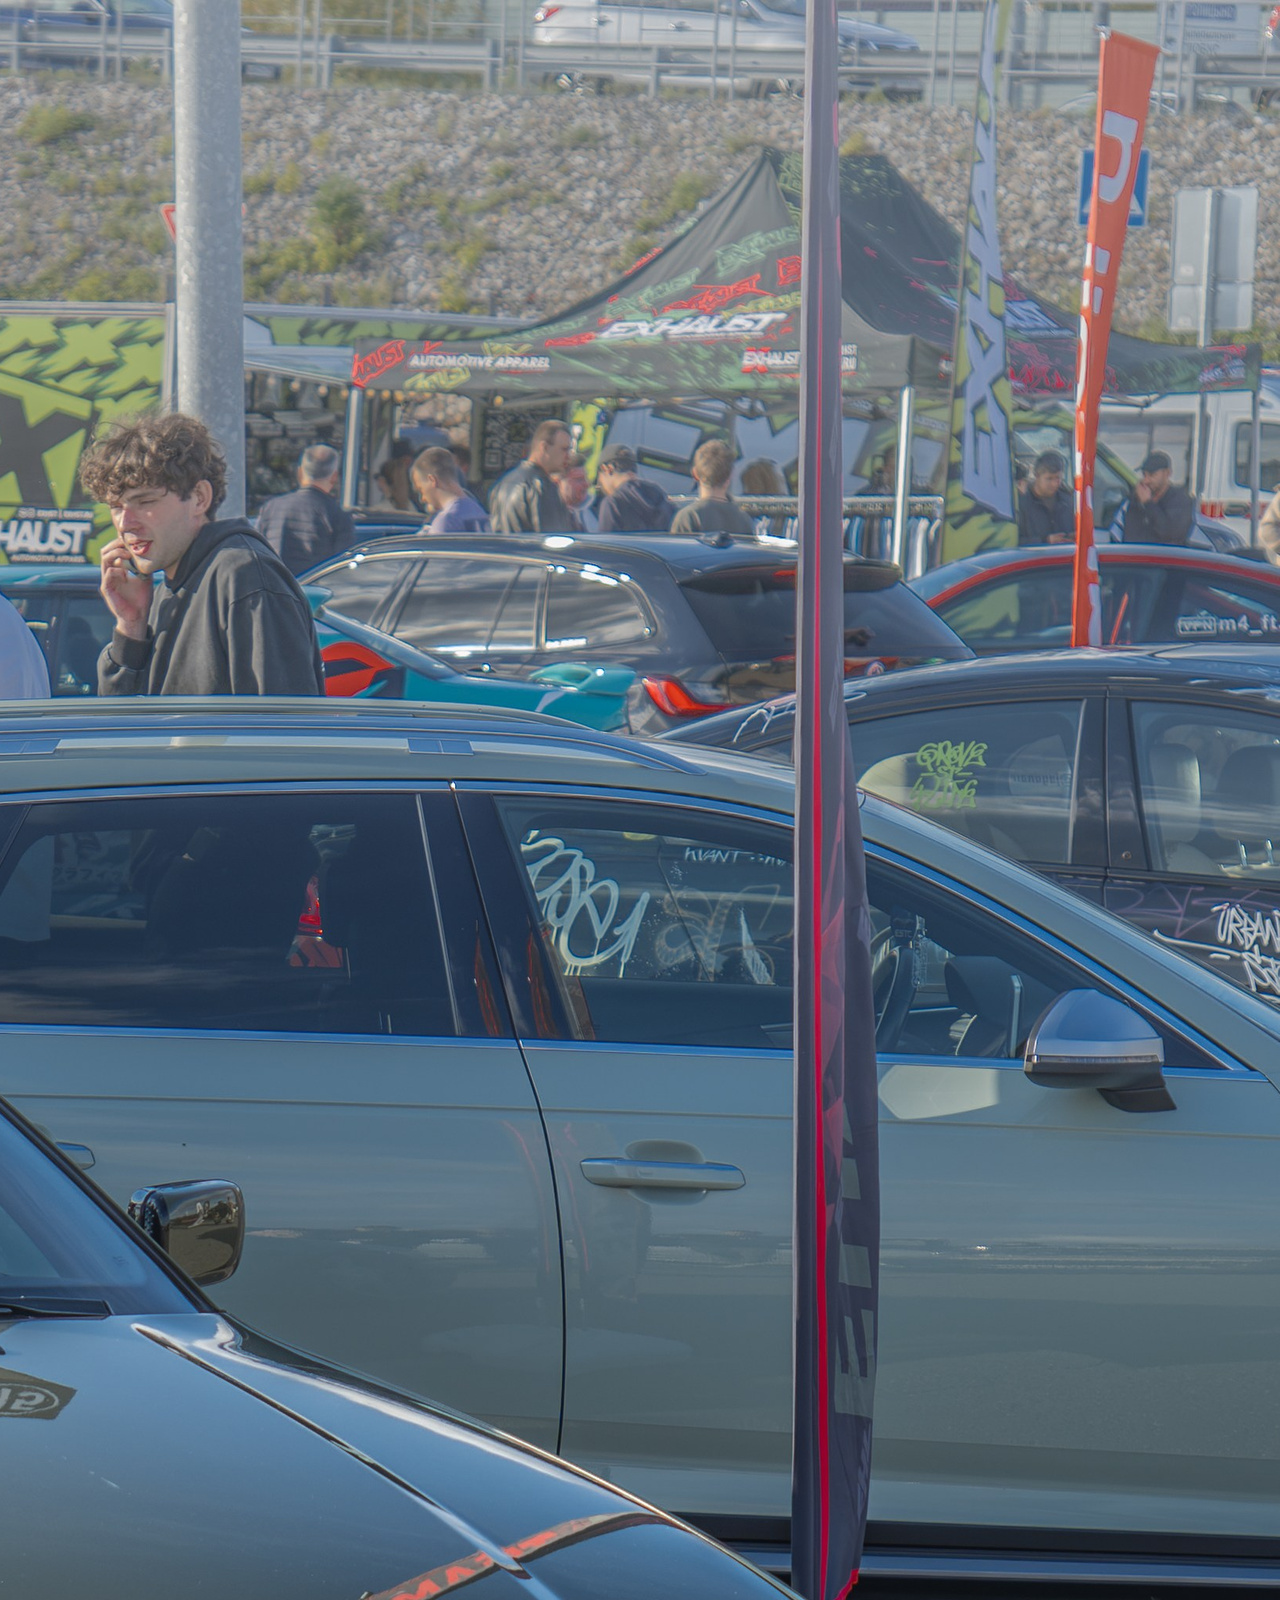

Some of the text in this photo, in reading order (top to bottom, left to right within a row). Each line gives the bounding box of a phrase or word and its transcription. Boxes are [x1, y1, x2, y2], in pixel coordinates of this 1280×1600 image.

[600, 311, 788, 338] EXHAUST
[409, 355, 551, 368] AUTOMOTIVE APPAREL
